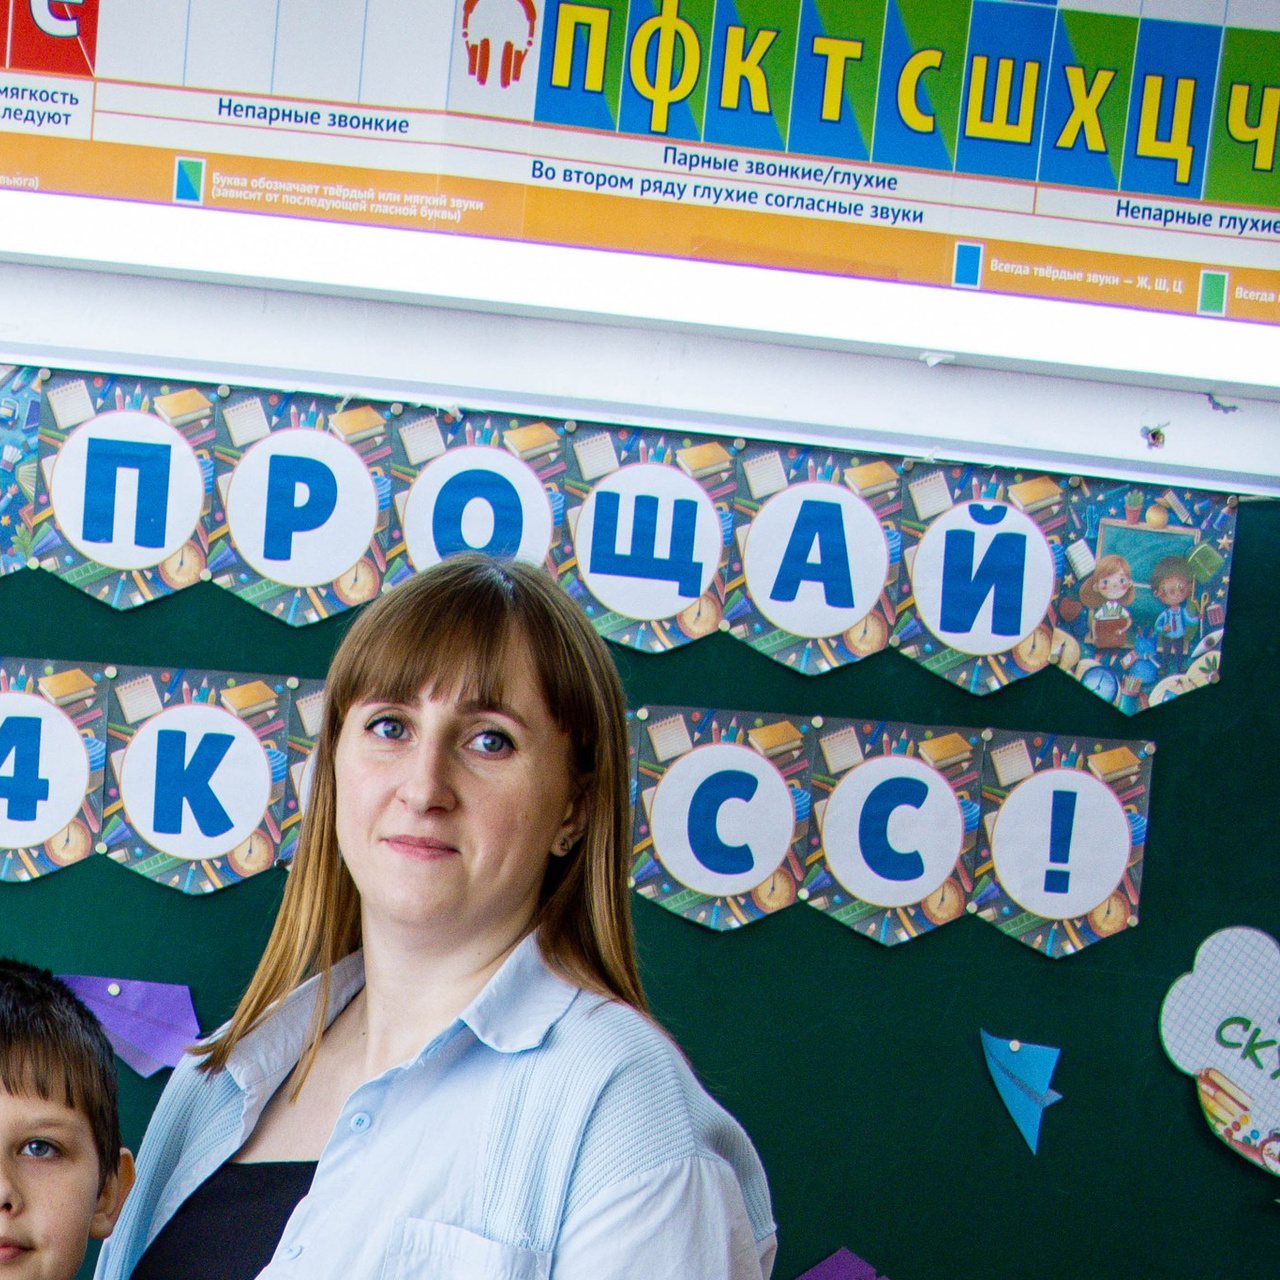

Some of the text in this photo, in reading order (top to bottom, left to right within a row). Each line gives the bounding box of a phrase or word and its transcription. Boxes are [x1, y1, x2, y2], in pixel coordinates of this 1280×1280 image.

[218, 97, 410, 134] Непарные звонкие
[663, 146, 899, 192] Парные звонкие/глухие
[211, 185, 462, 223] (зависит от последующей гласной буквы)
[212, 171, 484, 212] Буква обозначает твёрдый или мягкий звуки
[531, 160, 924, 227] Во втором ряду глухие согласные звуки
[1116, 199, 1280, 236] Непарные глухие
[990, 257, 1030, 276] Всегда
[1086, 271, 1120, 286] звуки
[1235, 286, 1276, 303] Всегда
[82, 436, 1028, 637] ПРОЩАЙ
[1215, 1015, 1280, 1081] СК
